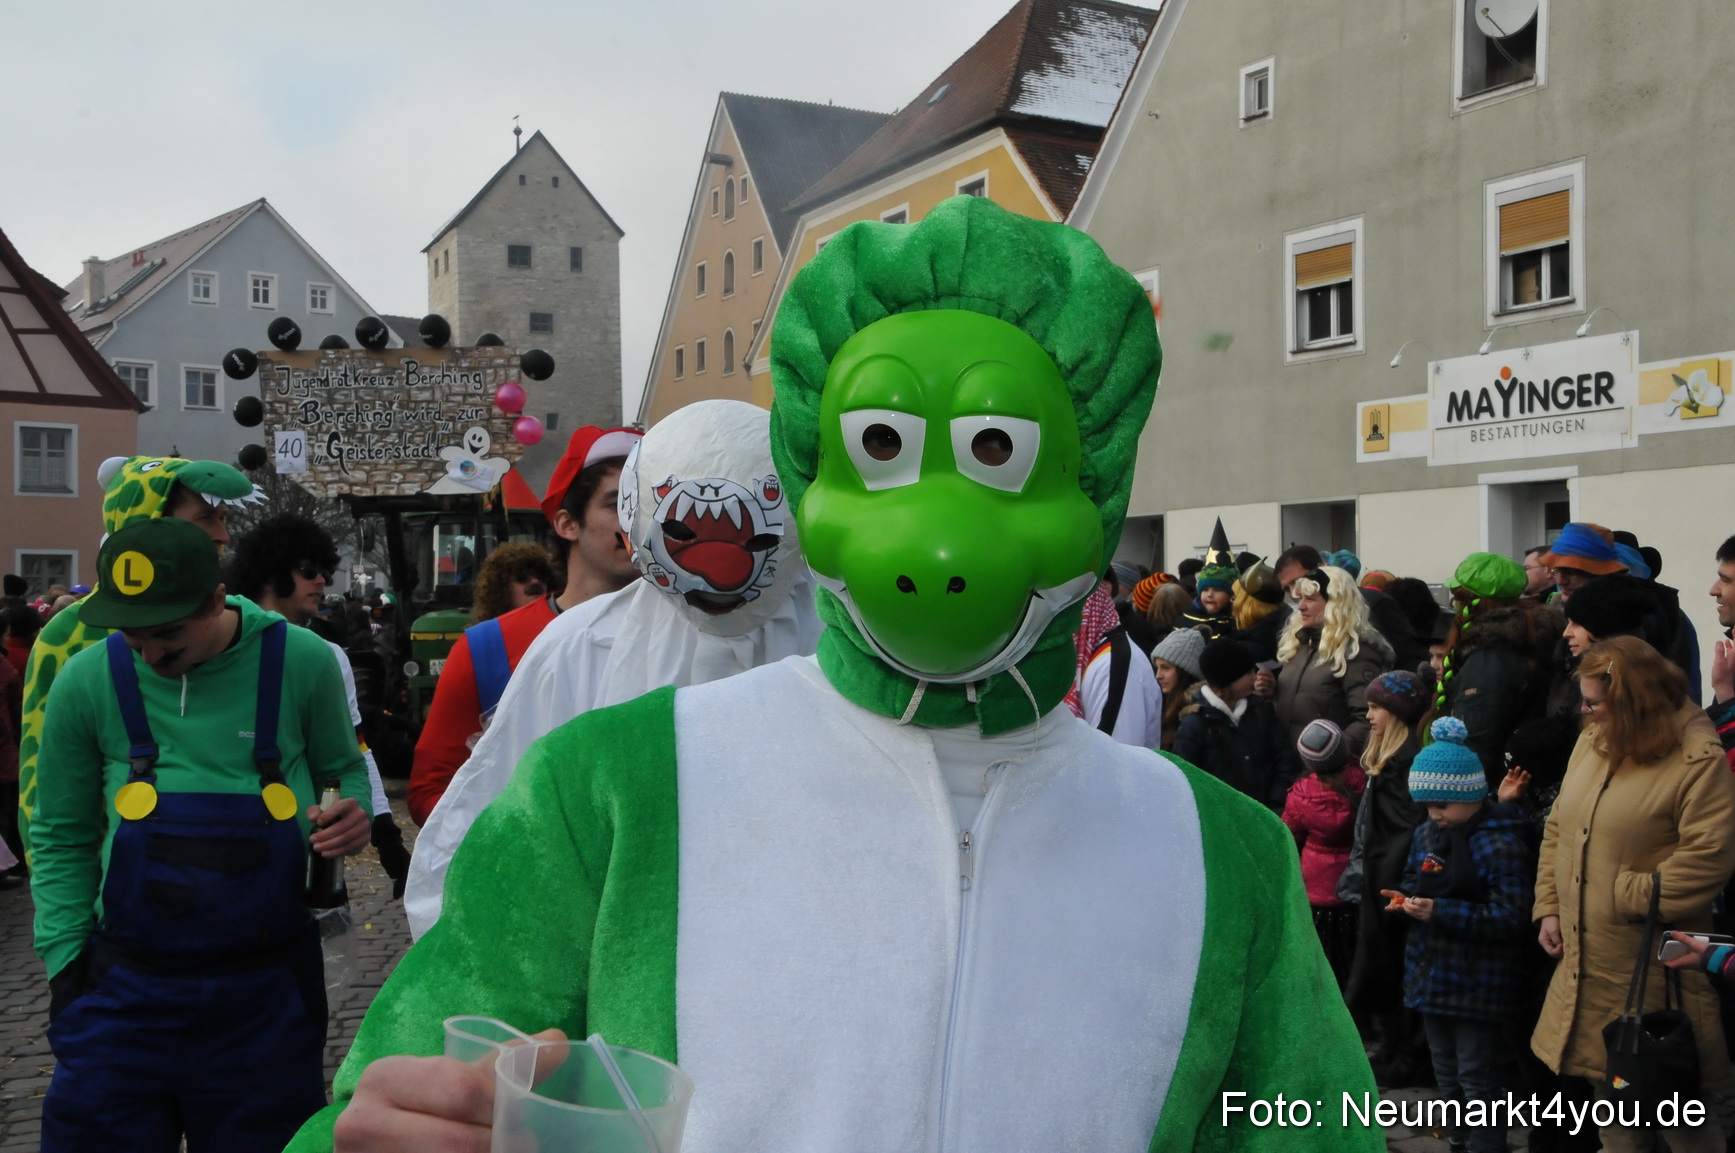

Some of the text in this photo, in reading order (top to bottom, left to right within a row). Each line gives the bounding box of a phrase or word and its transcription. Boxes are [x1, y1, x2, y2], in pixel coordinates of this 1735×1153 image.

[275, 360, 482, 398] Jugendrotkreuz Berching
[1446, 369, 1615, 423] MAYINGER
[457, 407, 484, 420] zur
[1470, 418, 1586, 442] BESTATTUNGEN
[278, 438, 302, 458] 40
[124, 558, 143, 588] L
